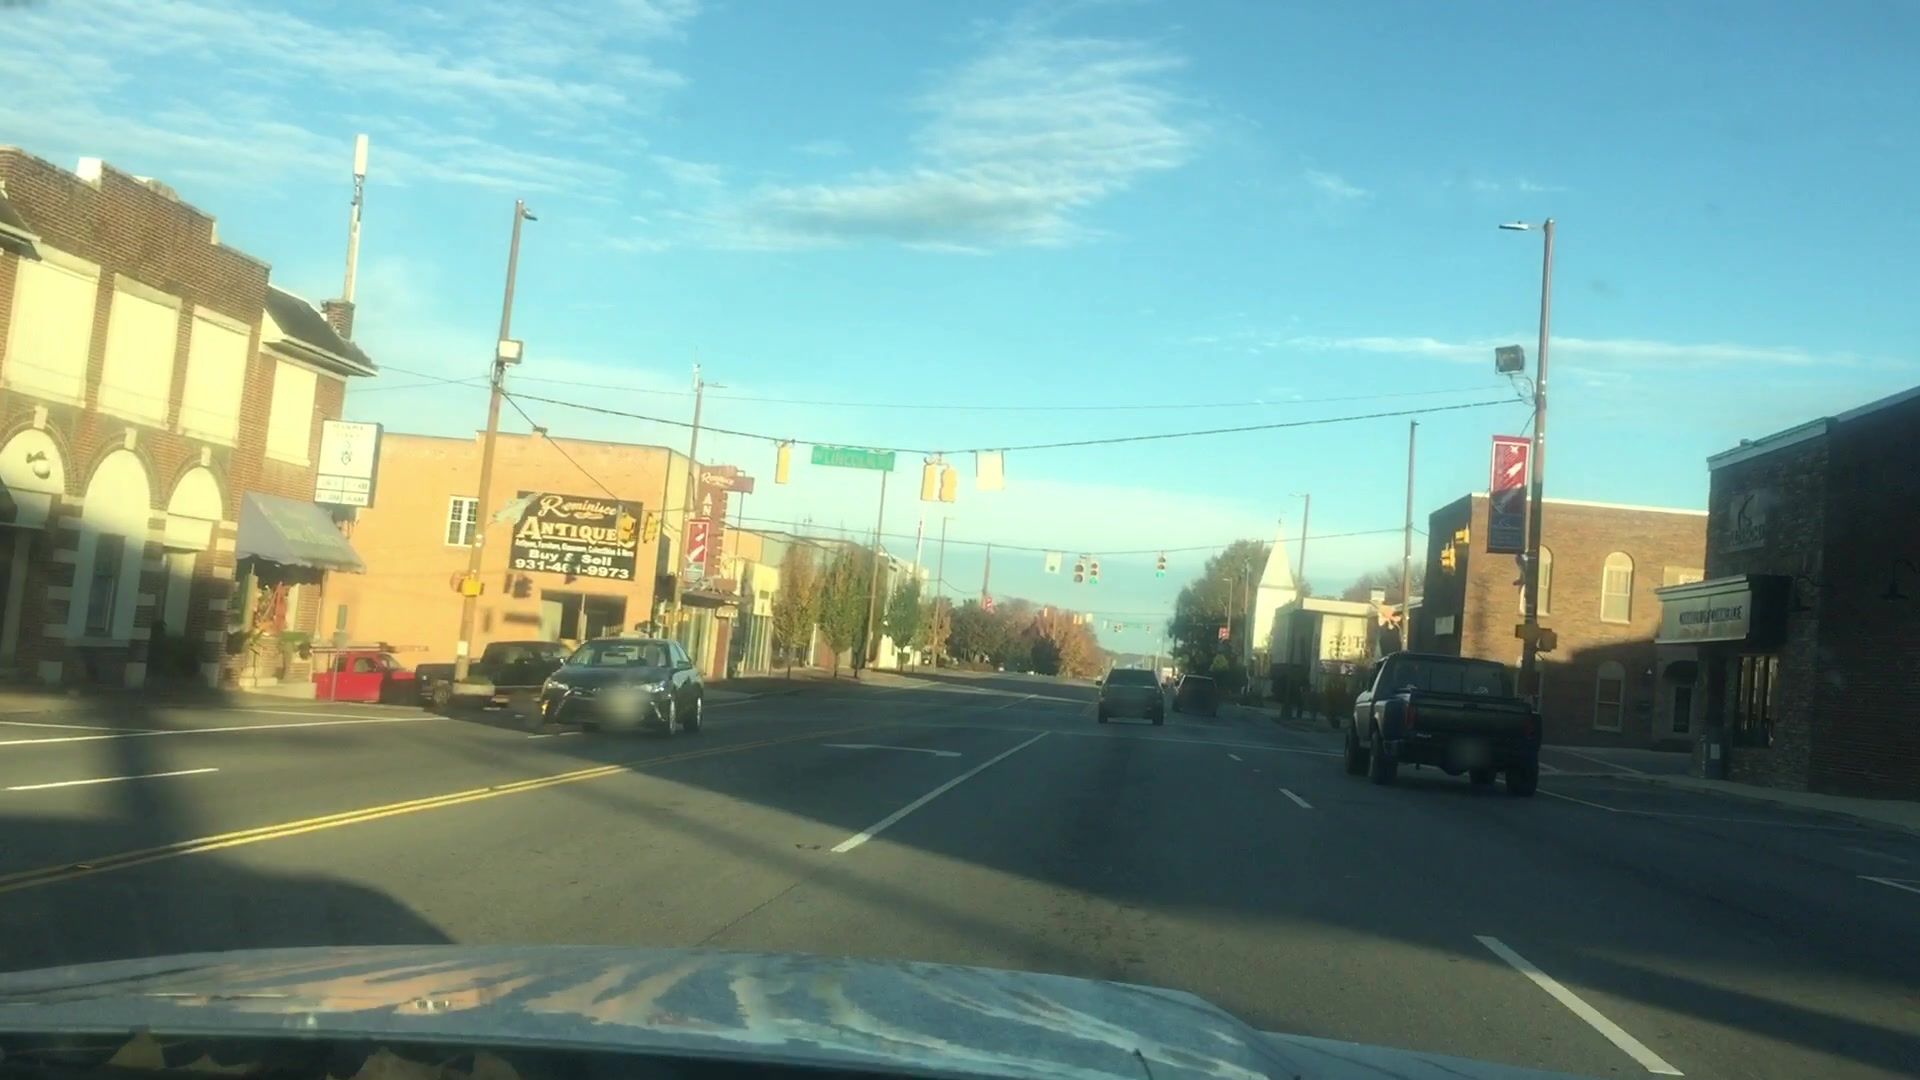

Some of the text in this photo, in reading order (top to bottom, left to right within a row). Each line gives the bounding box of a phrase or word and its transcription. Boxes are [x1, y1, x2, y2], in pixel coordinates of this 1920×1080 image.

[538, 495, 617, 518] Reminisce
[515, 515, 635, 548] ANTIQUE
[529, 549, 559, 563] Buy
[581, 554, 612, 566] Sell
